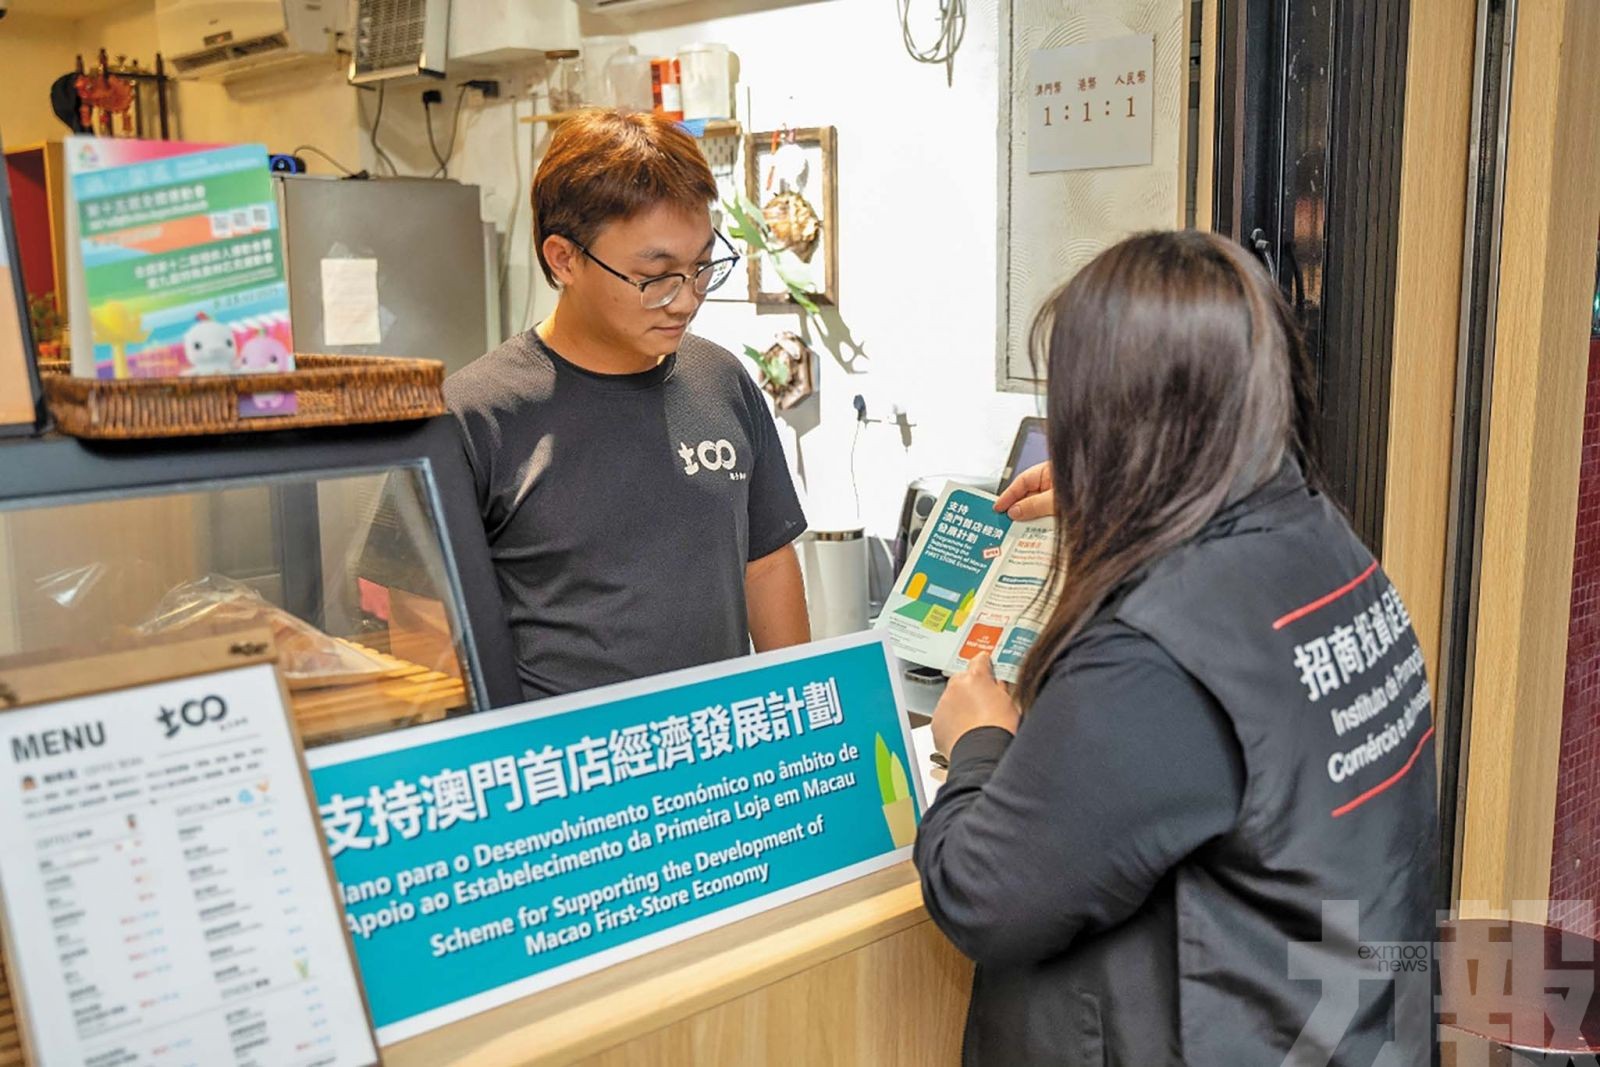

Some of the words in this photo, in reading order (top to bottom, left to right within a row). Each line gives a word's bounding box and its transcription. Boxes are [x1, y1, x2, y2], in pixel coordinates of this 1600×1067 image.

[947, 501, 969, 515] 支持
[11, 721, 106, 763] MENU
[318, 676, 844, 858] 支持澳門首店經濟發展計劃
[337, 876, 392, 904] lano
[396, 859, 450, 896] para
[453, 854, 470, 873] o
[474, 803, 649, 868] Desenvolvimento
[652, 772, 749, 816] Económico
[753, 767, 776, 787] no
[779, 749, 836, 780] âmbito
[838, 743, 860, 763] de
[346, 899, 416, 939] Apoio
[420, 891, 450, 915] ao
[454, 840, 624, 905] Estabelecimento
[628, 830, 652, 850] da
[655, 809, 732, 844] Primeira
[734, 794, 771, 822] Loja
[775, 789, 800, 809] em
[803, 771, 856, 800] Macau
[430, 916, 515, 957] Scheme
[518, 905, 549, 930] for
[553, 870, 660, 918] Supporting
[662, 860, 701, 883] the
[696, 821, 805, 872] Development
[806, 813, 825, 835] of
[525, 919, 593, 956] Macao
[595, 889, 690, 933] First-Store
[692, 861, 769, 900] Economy
